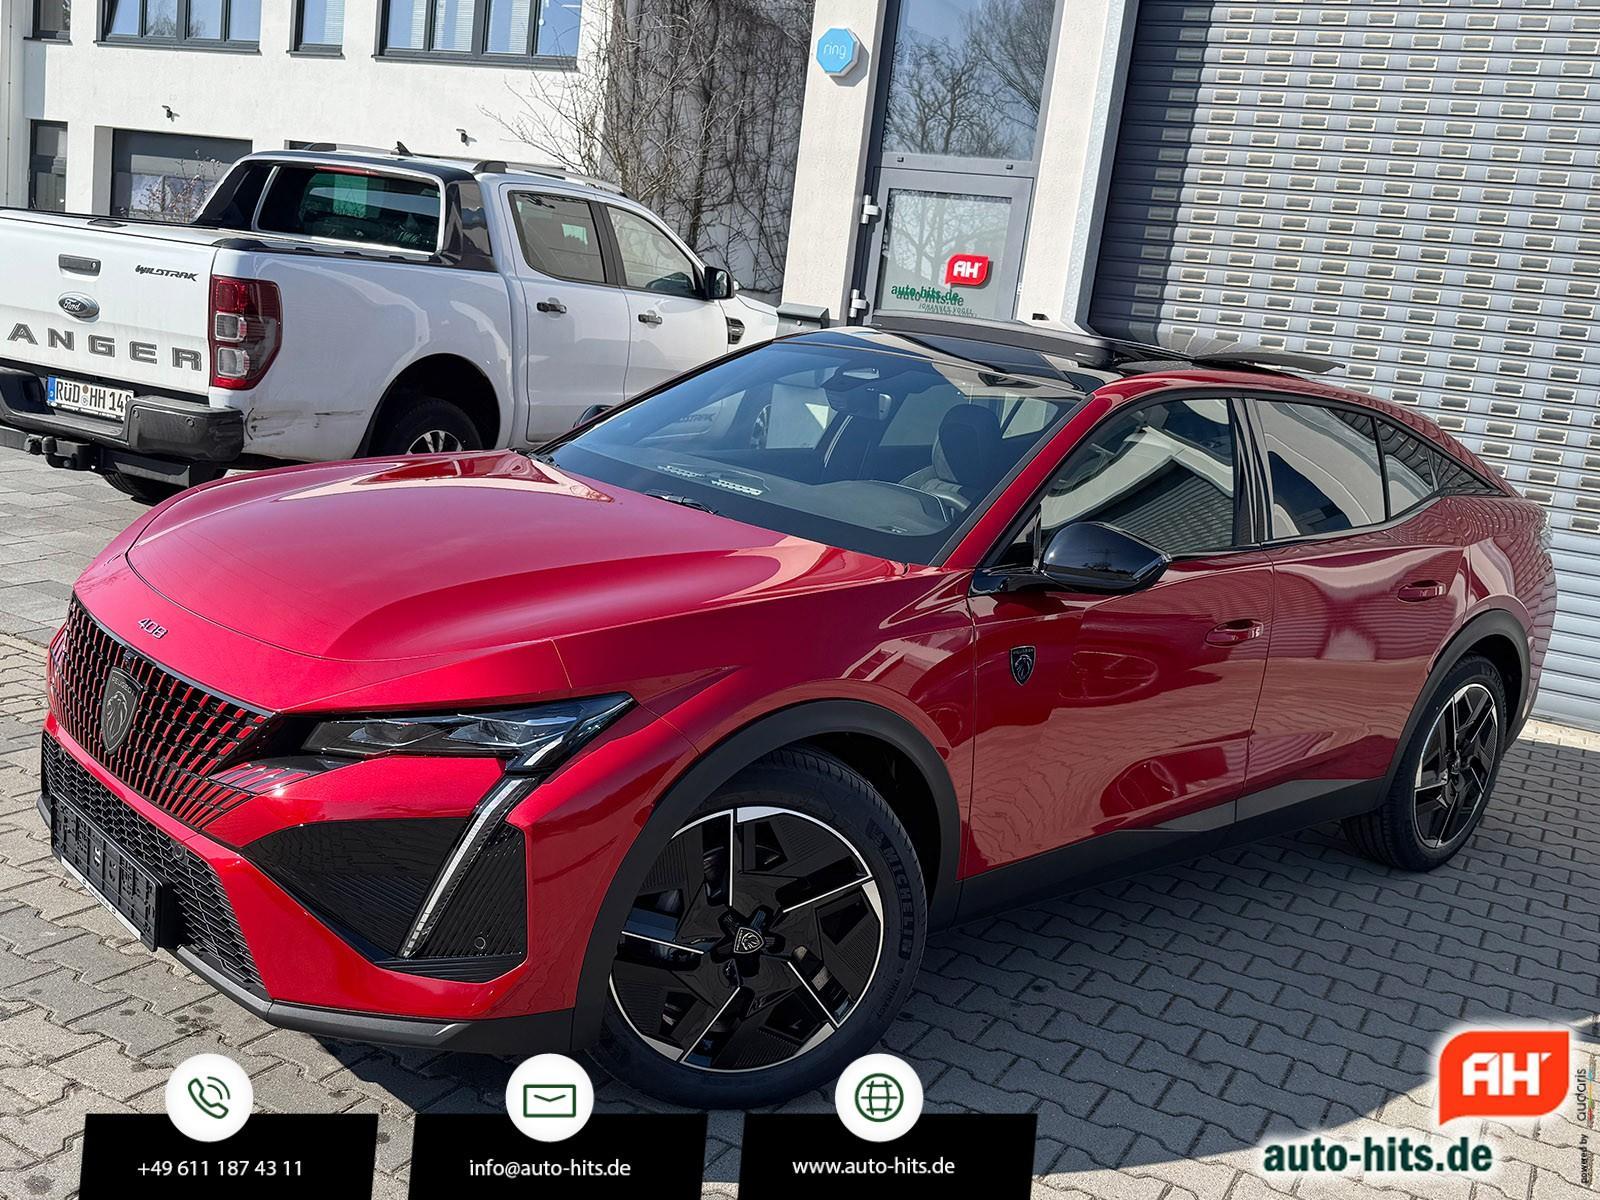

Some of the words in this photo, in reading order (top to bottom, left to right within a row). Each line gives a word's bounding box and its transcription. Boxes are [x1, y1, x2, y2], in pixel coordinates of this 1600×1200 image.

[823, 42, 847, 60] ring
[135, 264, 199, 282] WILDTRAK
[63, 298, 81, 312] Ford
[89, 387, 106, 410] HH
[138, 617, 168, 639] 408
[885, 847, 915, 957] MICHELIN
